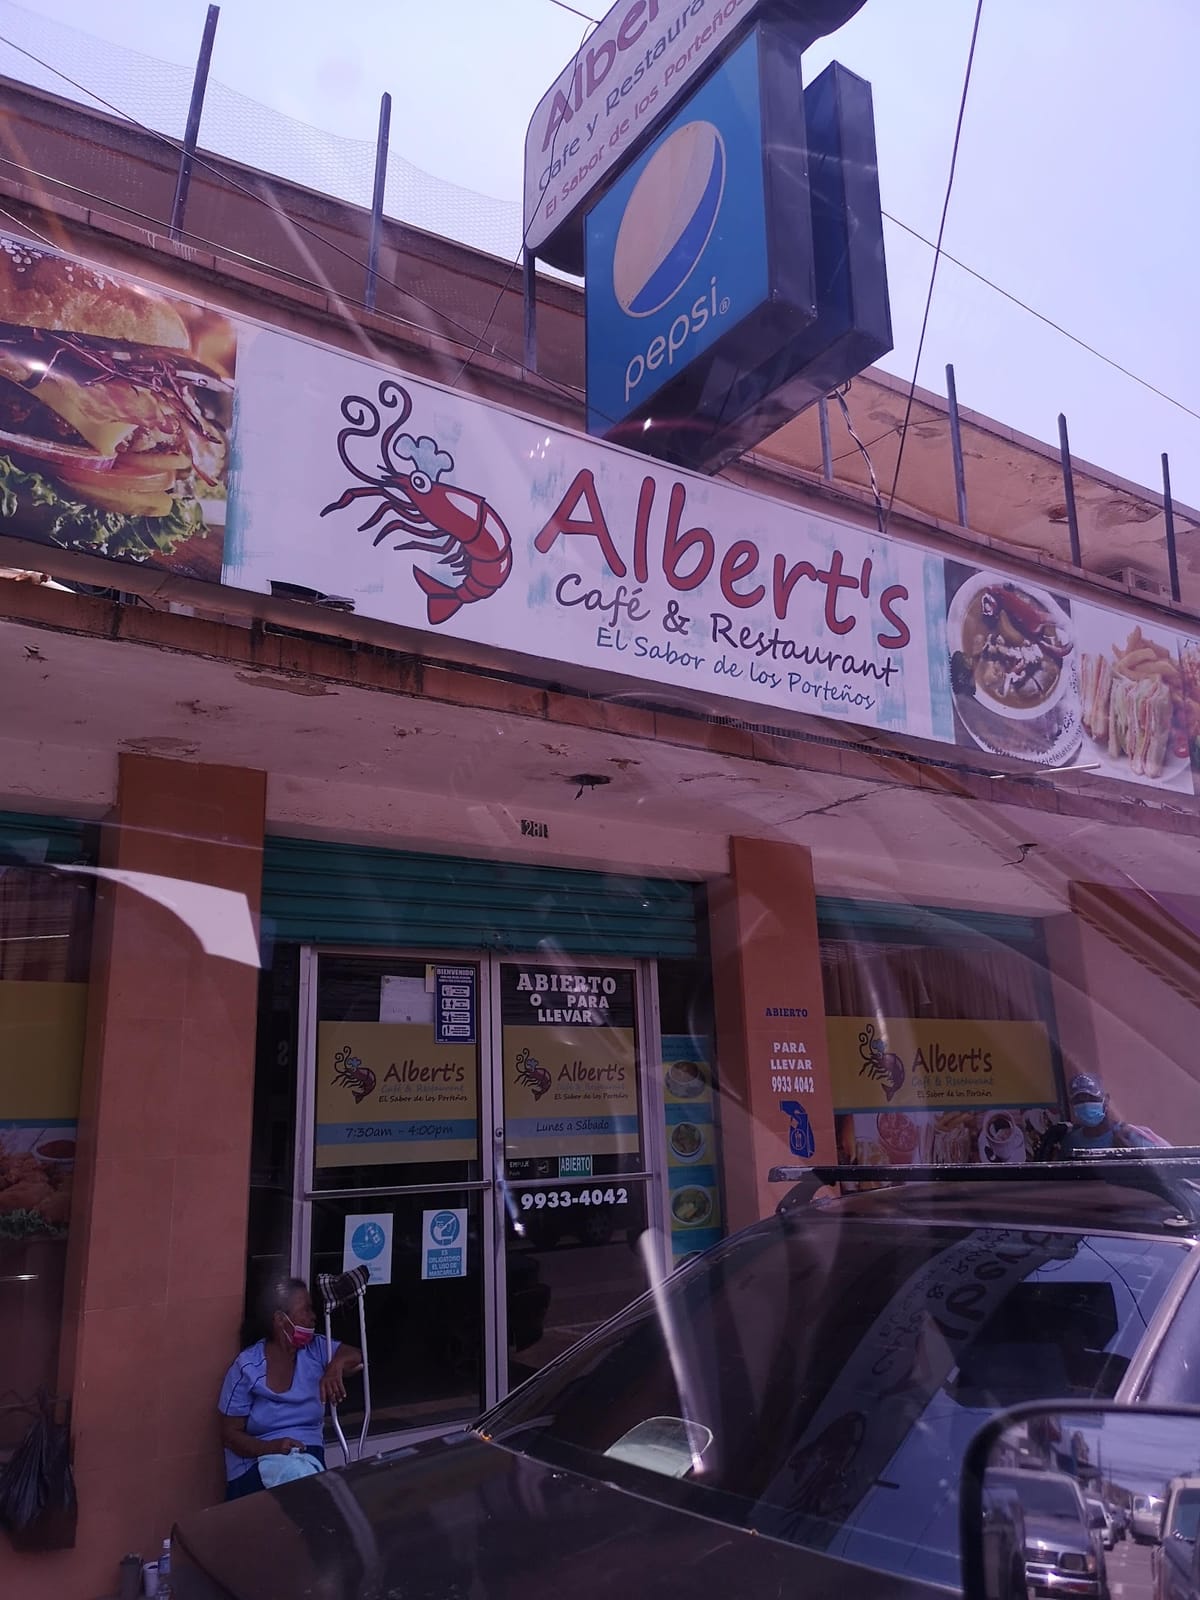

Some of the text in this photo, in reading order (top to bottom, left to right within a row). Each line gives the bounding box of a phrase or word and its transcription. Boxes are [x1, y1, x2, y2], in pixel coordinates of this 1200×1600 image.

[544, 195, 557, 221] El
[608, 118, 631, 148] de
[633, 85, 659, 120] los
[624, 276, 719, 402] pepsi
[533, 468, 911, 650] Albert's
[555, 572, 900, 687] Café & Restaurant
[633, 639, 706, 671] Sabor
[713, 658, 743, 679] de
[749, 661, 782, 690] los
[788, 671, 876, 711] Porteños
[516, 973, 617, 995] ABIERTO
[530, 993, 610, 1009] O PARA
[537, 1008, 593, 1023] LLEVAR
[765, 1007, 808, 1018] ABIERTO
[773, 1042, 806, 1054] PARA
[911, 1043, 993, 1073] Albert's
[383, 1060, 465, 1083] Albert's
[558, 1061, 625, 1083] Albert's
[770, 1058, 812, 1071] LLEVAR
[771, 1075, 815, 1093] 9933 4042
[345, 1126, 392, 1138] 7:30am
[408, 1124, 454, 1138] 4:00pm
[536, 1119, 609, 1132] Lunes a Sábado
[560, 1156, 591, 1172] ABIERTO
[521, 1188, 628, 1210] 9933-4042
